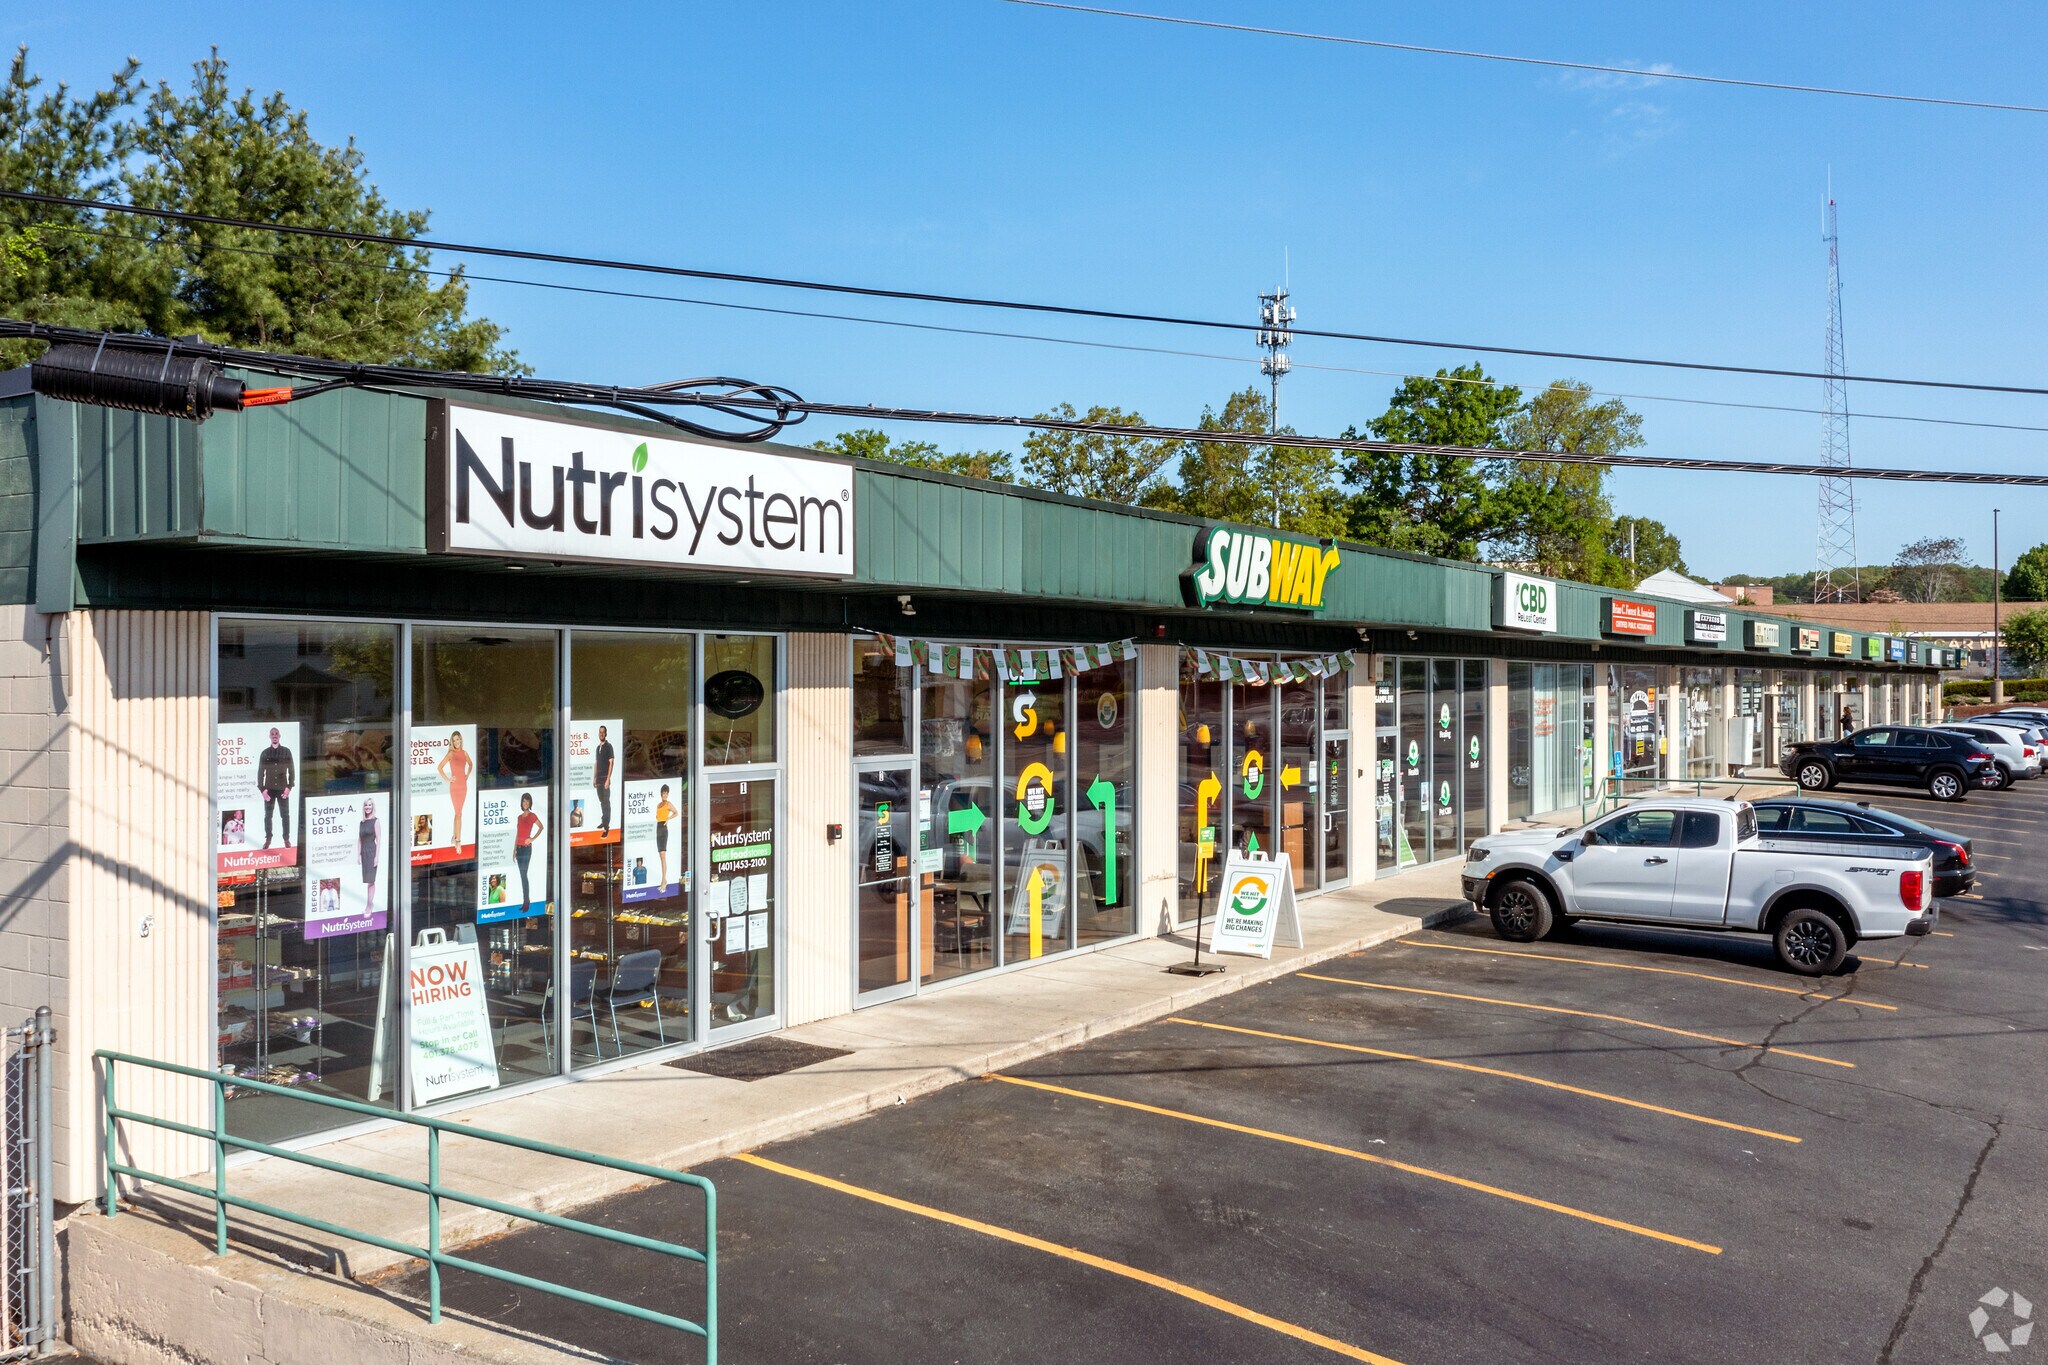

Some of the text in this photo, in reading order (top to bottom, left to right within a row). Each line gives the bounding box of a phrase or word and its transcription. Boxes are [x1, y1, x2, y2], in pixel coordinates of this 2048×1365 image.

[1197, 530, 1341, 607] SUBWAY
[1520, 583, 1547, 613] CBD
[1533, 614, 1547, 625] Center
[583, 732, 590, 740] B.
[237, 737, 247, 746] B.
[411, 748, 429, 756] OST
[576, 748, 590, 756] LBS.
[231, 756, 252, 765] LBS.
[418, 756, 435, 765] LBS.
[741, 783, 746, 793] 1
[628, 791, 646, 801] Kathy
[483, 800, 508, 809] Lisa D.
[312, 805, 357, 817] Sydney A.
[484, 809, 504, 817] LOST
[628, 806, 650, 815] 70 LBS.
[312, 816, 336, 826] LOST
[484, 817, 510, 826] 50 LBS.
[312, 825, 346, 835] 68 LBS.
[711, 828, 771, 848] Nutrisystem
[224, 852, 281, 868] Nutrisystem
[718, 857, 767, 873] (401)453-2100
[1844, 866, 1895, 874] SPORT
[322, 918, 373, 934] Nutrisystem
[1242, 919, 1264, 927] MAKING
[1235, 925, 1263, 933] CHANGES
[411, 960, 468, 990] NOW
[412, 982, 472, 1007] HIRING
[420, 1040, 440, 1049] Stop
[462, 1029, 478, 1040] Call
[425, 1065, 483, 1087] Nutrisystem
